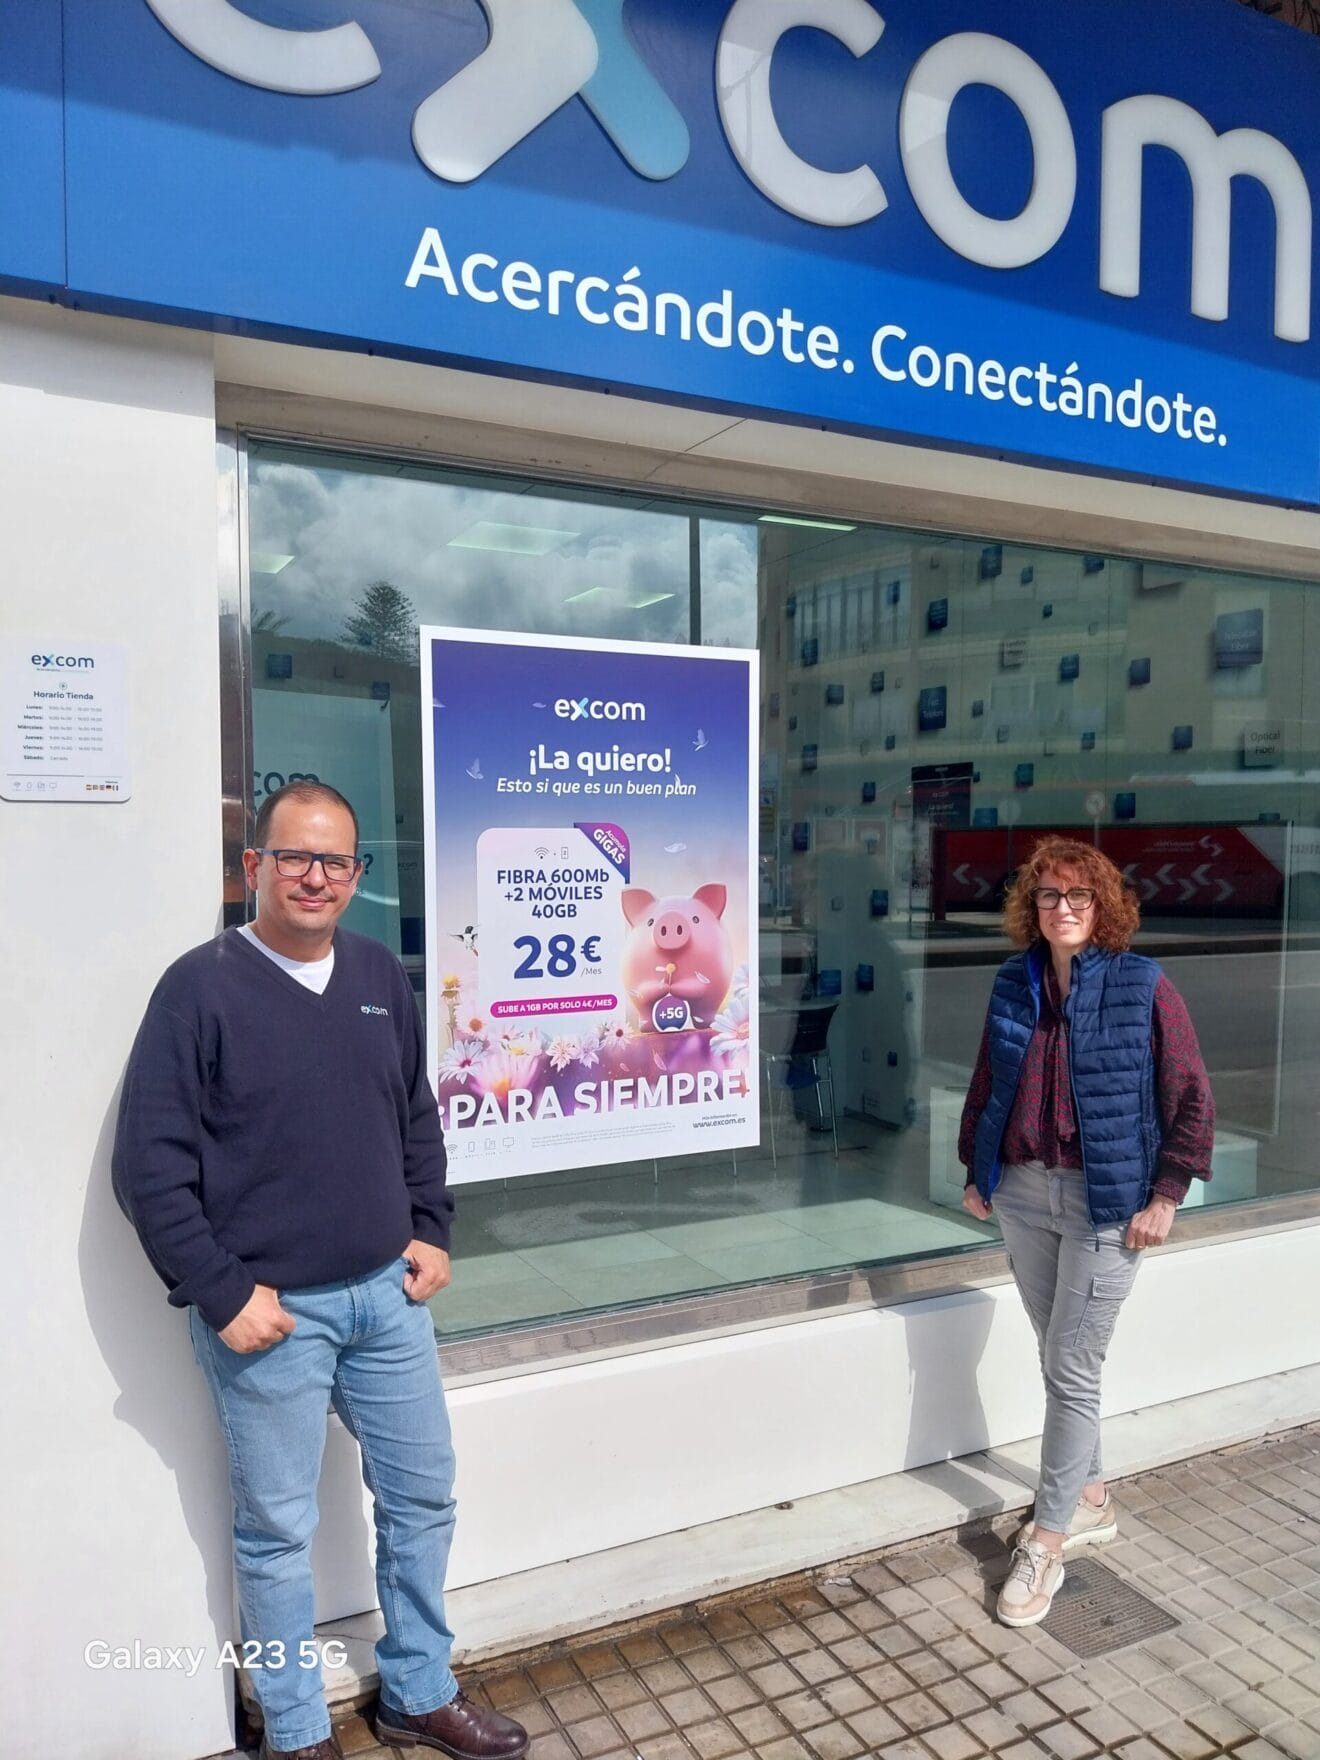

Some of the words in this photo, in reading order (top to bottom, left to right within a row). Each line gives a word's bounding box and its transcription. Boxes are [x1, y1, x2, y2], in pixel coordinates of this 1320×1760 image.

[404, 226, 855, 375] Acercándote.
[870, 324, 1228, 447] Conectándote.
[31, 653, 95, 668] excom
[33, 691, 65, 699] Horario
[66, 692, 94, 700] Tienda
[554, 697, 646, 721] excom
[529, 744, 570, 775] ¡La
[576, 744, 672, 776] quiero!
[497, 778, 532, 793] Esto
[536, 779, 549, 793] si
[552, 781, 580, 796] que
[584, 782, 600, 794] es
[604, 782, 623, 794] un
[626, 780, 662, 795] buen
[665, 779, 697, 798] plan
[593, 829, 626, 864] GIGAS
[497, 869, 547, 884] FIBRA
[551, 868, 610, 883] 600Mb
[504, 887, 524, 901] +2
[528, 882, 603, 901] MÓVILES
[531, 903, 578, 918] 40GB
[581, 967, 602, 978] /Mes
[360, 1004, 389, 1016] excom
[497, 1005, 518, 1013] SUBE
[526, 1004, 542, 1012] 1GB
[542, 1003, 559, 1011] POR
[559, 1002, 581, 1010] SOLO
[581, 999, 613, 1009] 4€/MES
[659, 1006, 684, 1019] +5G
[692, 1117, 746, 1128] www.excom.es
